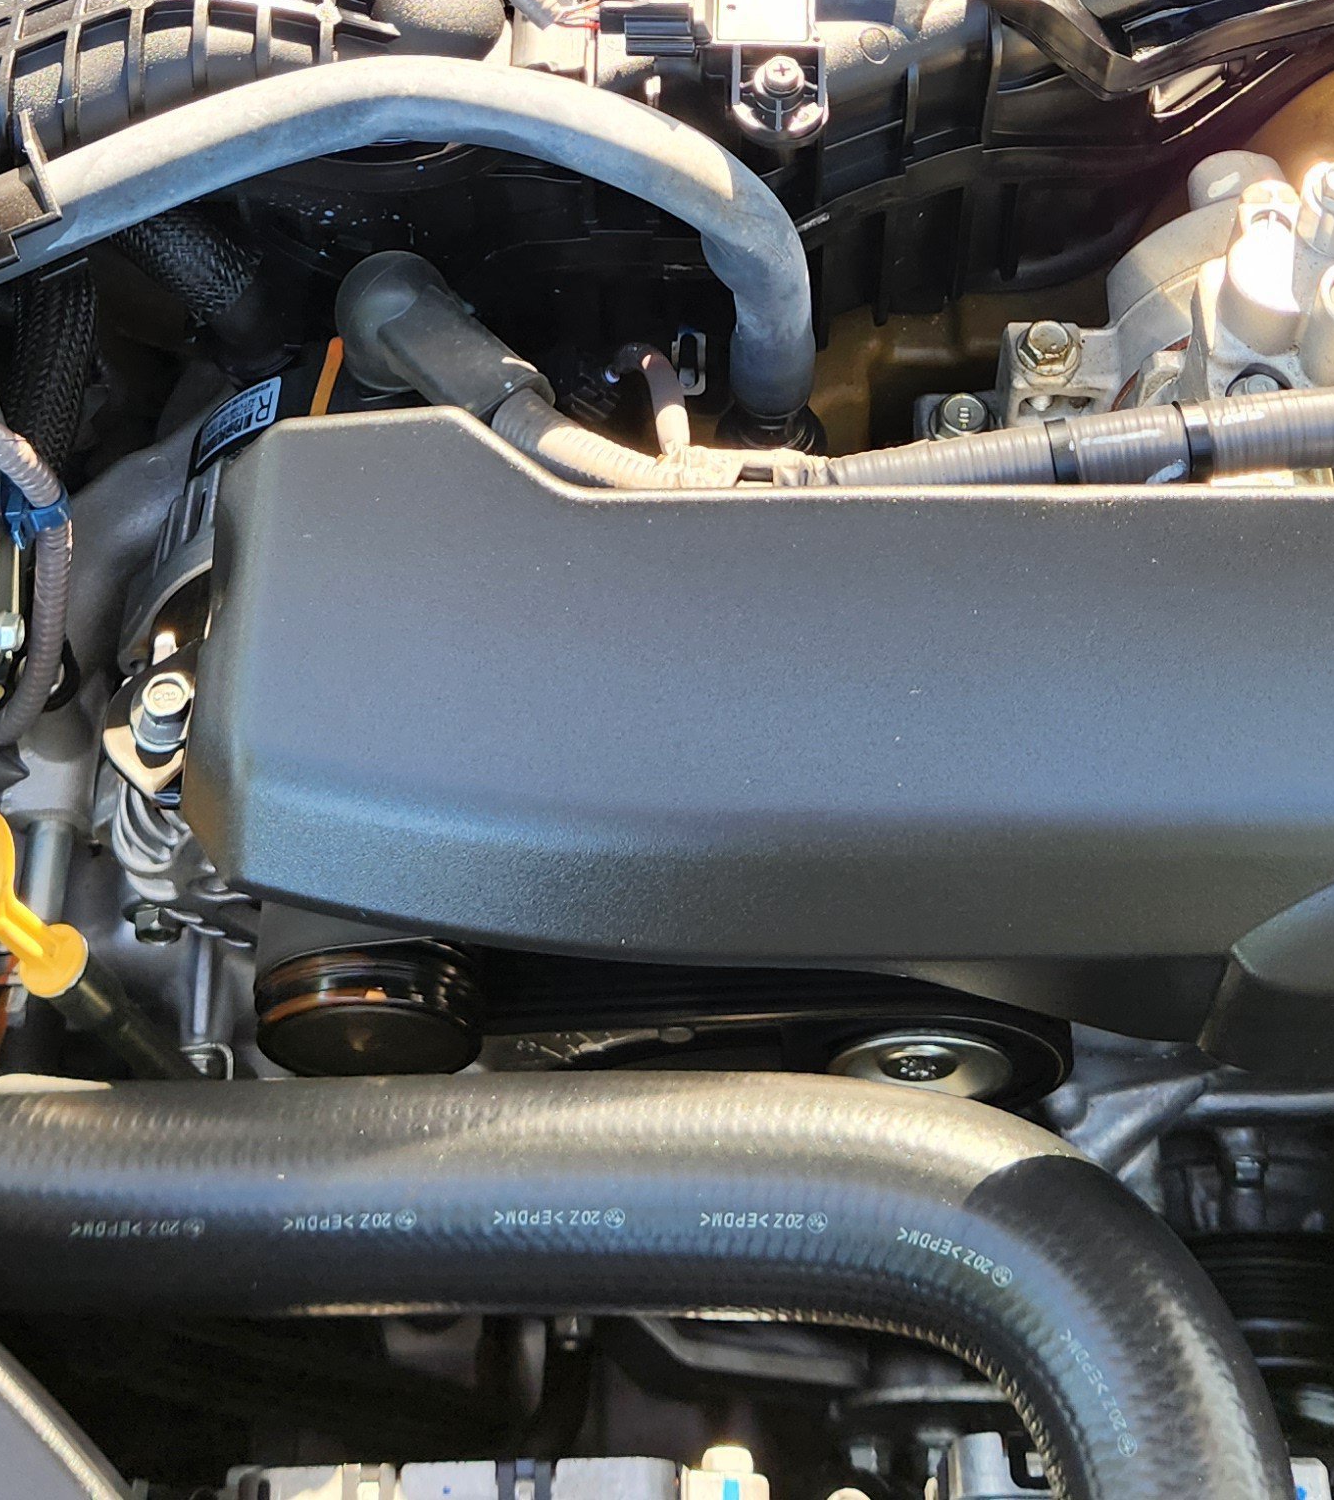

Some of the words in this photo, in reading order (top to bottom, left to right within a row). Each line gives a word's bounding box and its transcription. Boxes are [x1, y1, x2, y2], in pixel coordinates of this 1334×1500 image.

[255, 391, 273, 423] R
[569, 1209, 601, 1225] 20Z
[774, 1212, 804, 1228] 20Z
